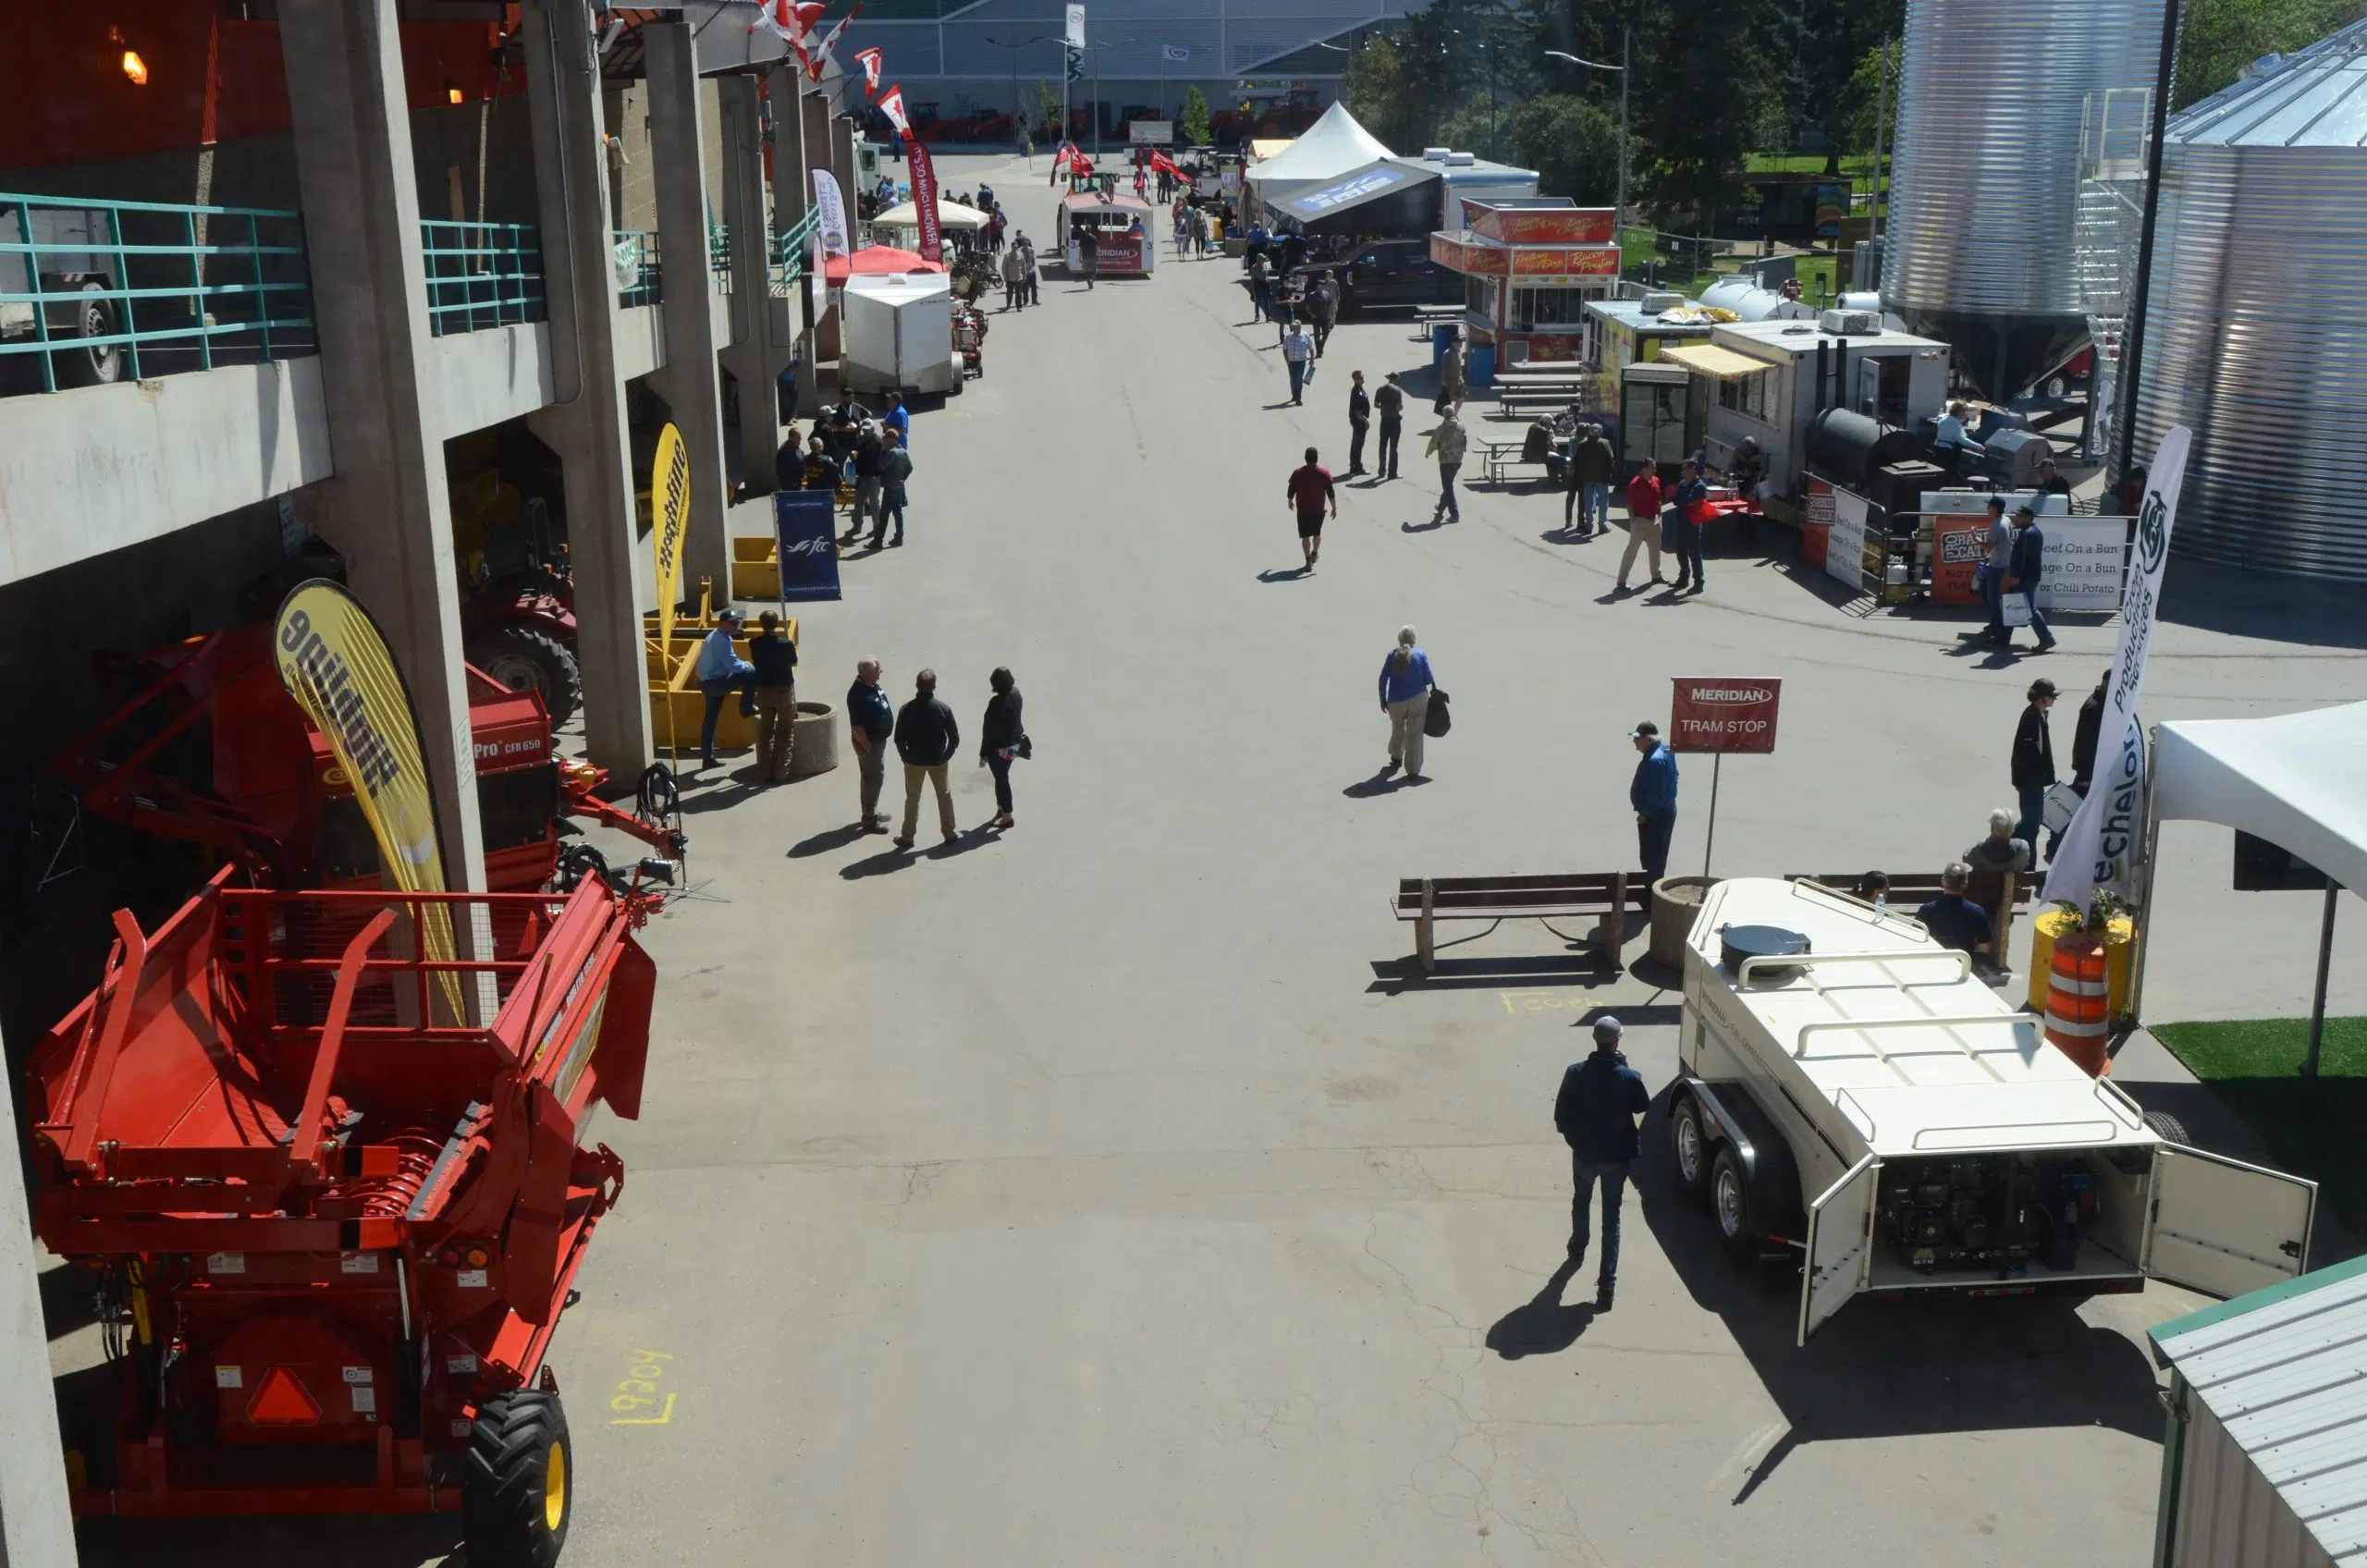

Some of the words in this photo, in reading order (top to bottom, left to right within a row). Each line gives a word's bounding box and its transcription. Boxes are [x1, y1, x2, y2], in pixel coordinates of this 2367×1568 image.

[915, 165, 926, 178] SO
[923, 210, 938, 245] MOWER
[1147, 241, 1153, 250] 3
[806, 535, 830, 557] fcc
[2042, 543, 2063, 553] eef
[2066, 543, 2083, 554] On
[2096, 544, 2117, 554] Bun
[2066, 563, 2082, 572] On
[2095, 563, 2116, 573] Bun
[2054, 582, 2079, 593] Chili
[2081, 583, 2115, 593] Potato
[2125, 562, 2140, 625] Crop
[2115, 575, 2144, 715] Production
[1691, 688, 1763, 701] MERIDIAN
[1681, 719, 1723, 732] TRAM
[1727, 720, 1767, 733] STOP
[505, 742, 521, 753] CFR
[522, 740, 541, 751] 650
